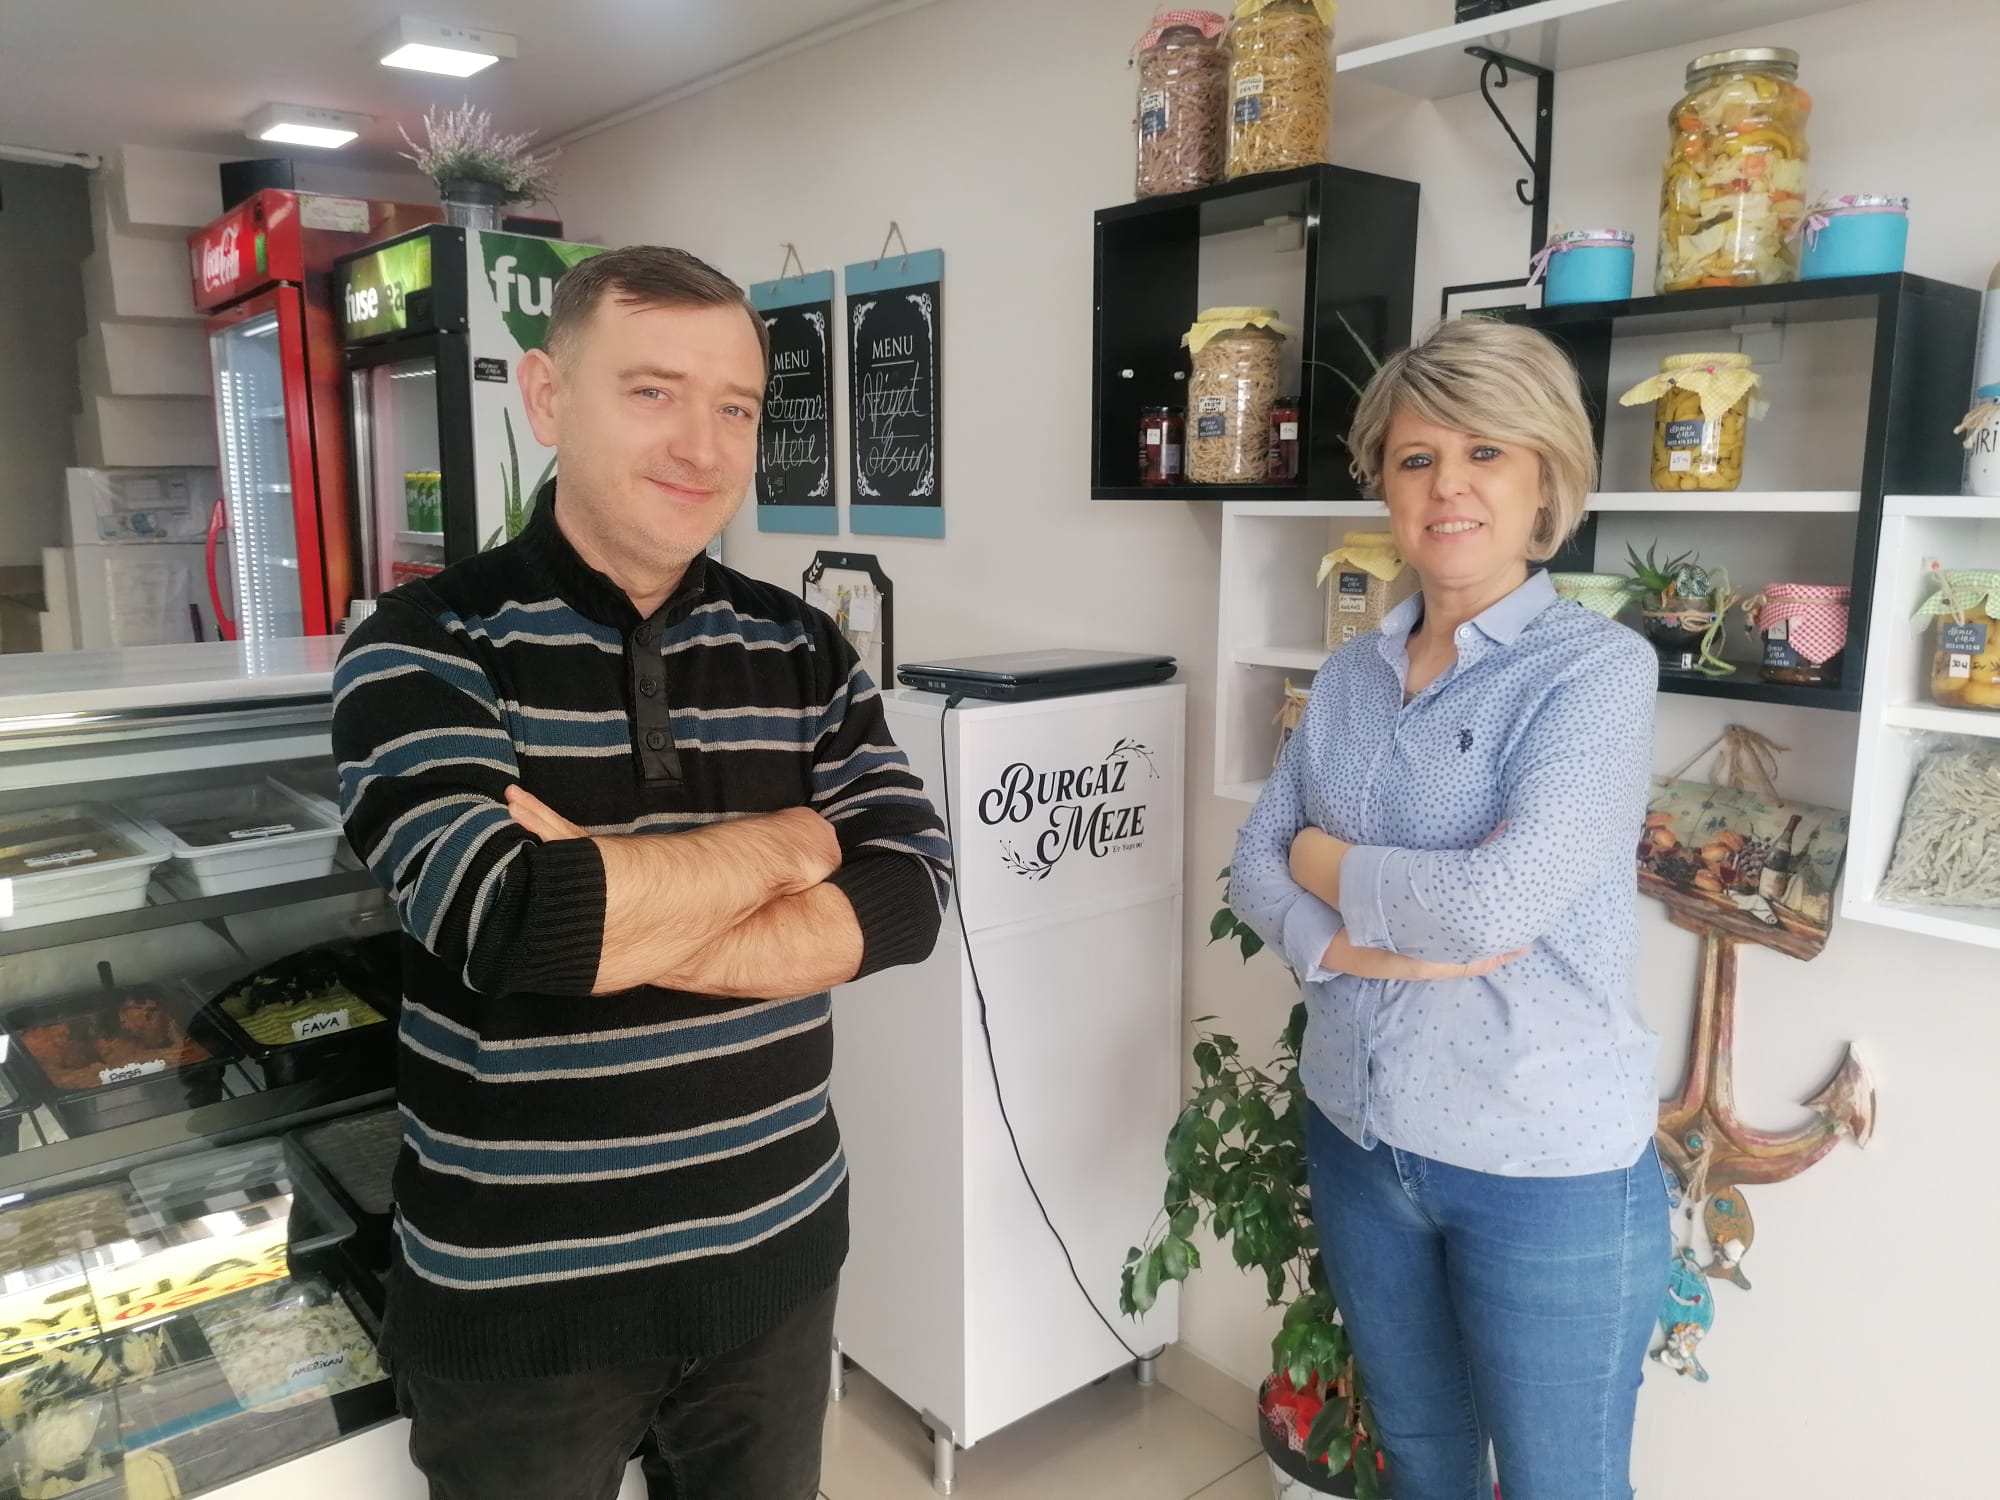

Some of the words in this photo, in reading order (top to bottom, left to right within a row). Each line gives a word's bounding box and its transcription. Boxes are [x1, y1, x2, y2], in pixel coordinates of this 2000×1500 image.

[345, 282, 379, 324] fuse
[774, 349, 810, 371] MENU
[872, 335, 914, 359] MENU
[978, 760, 1129, 825] BURGAZ
[1036, 802, 1147, 864] MEZE
[302, 1016, 340, 1036] FAVA
